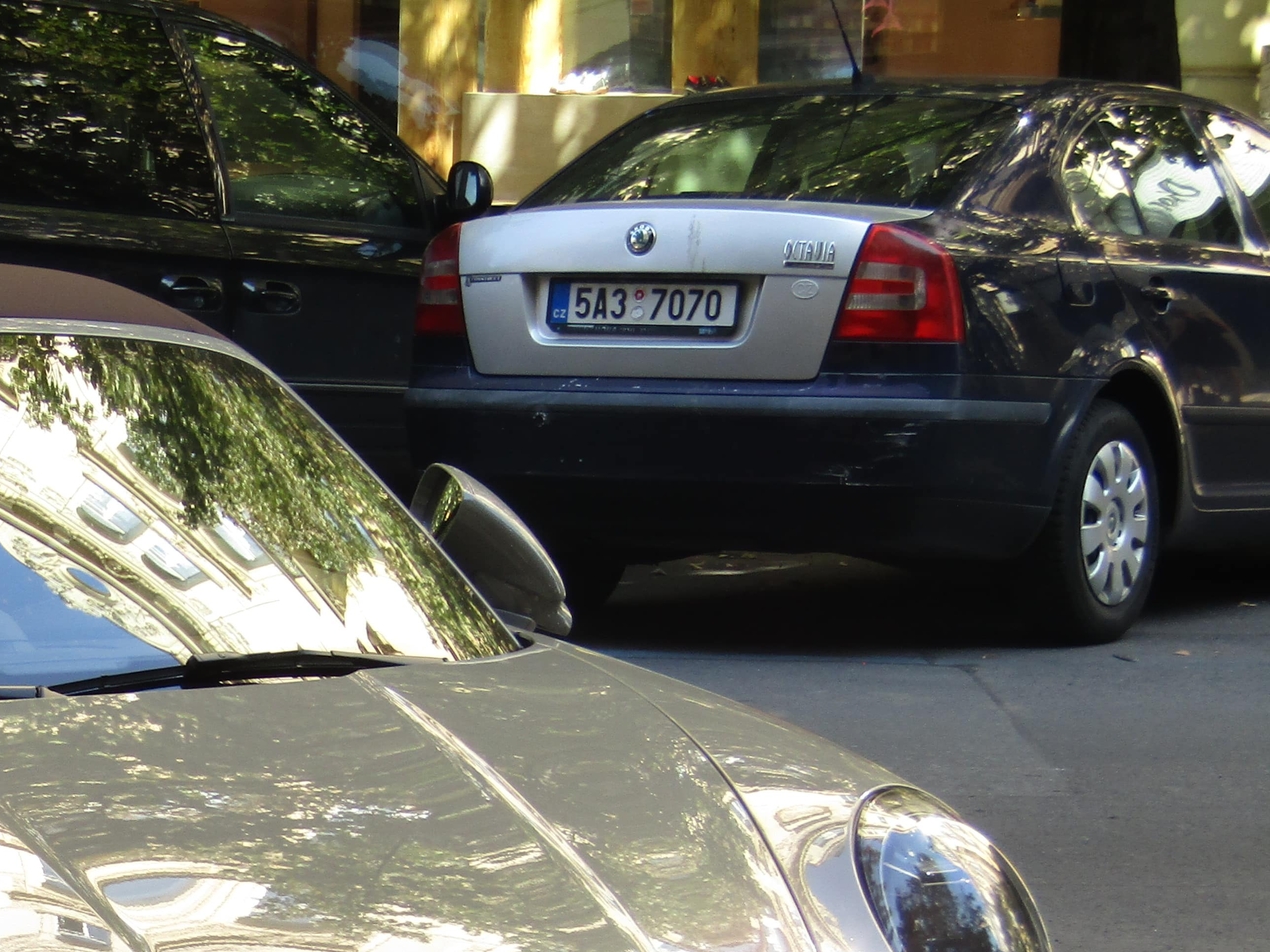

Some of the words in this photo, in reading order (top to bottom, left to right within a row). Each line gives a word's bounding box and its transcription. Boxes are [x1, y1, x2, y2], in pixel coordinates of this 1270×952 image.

[553, 309, 567, 319] CZ
[575, 287, 628, 320] 5A3
[649, 288, 722, 322] 7070
